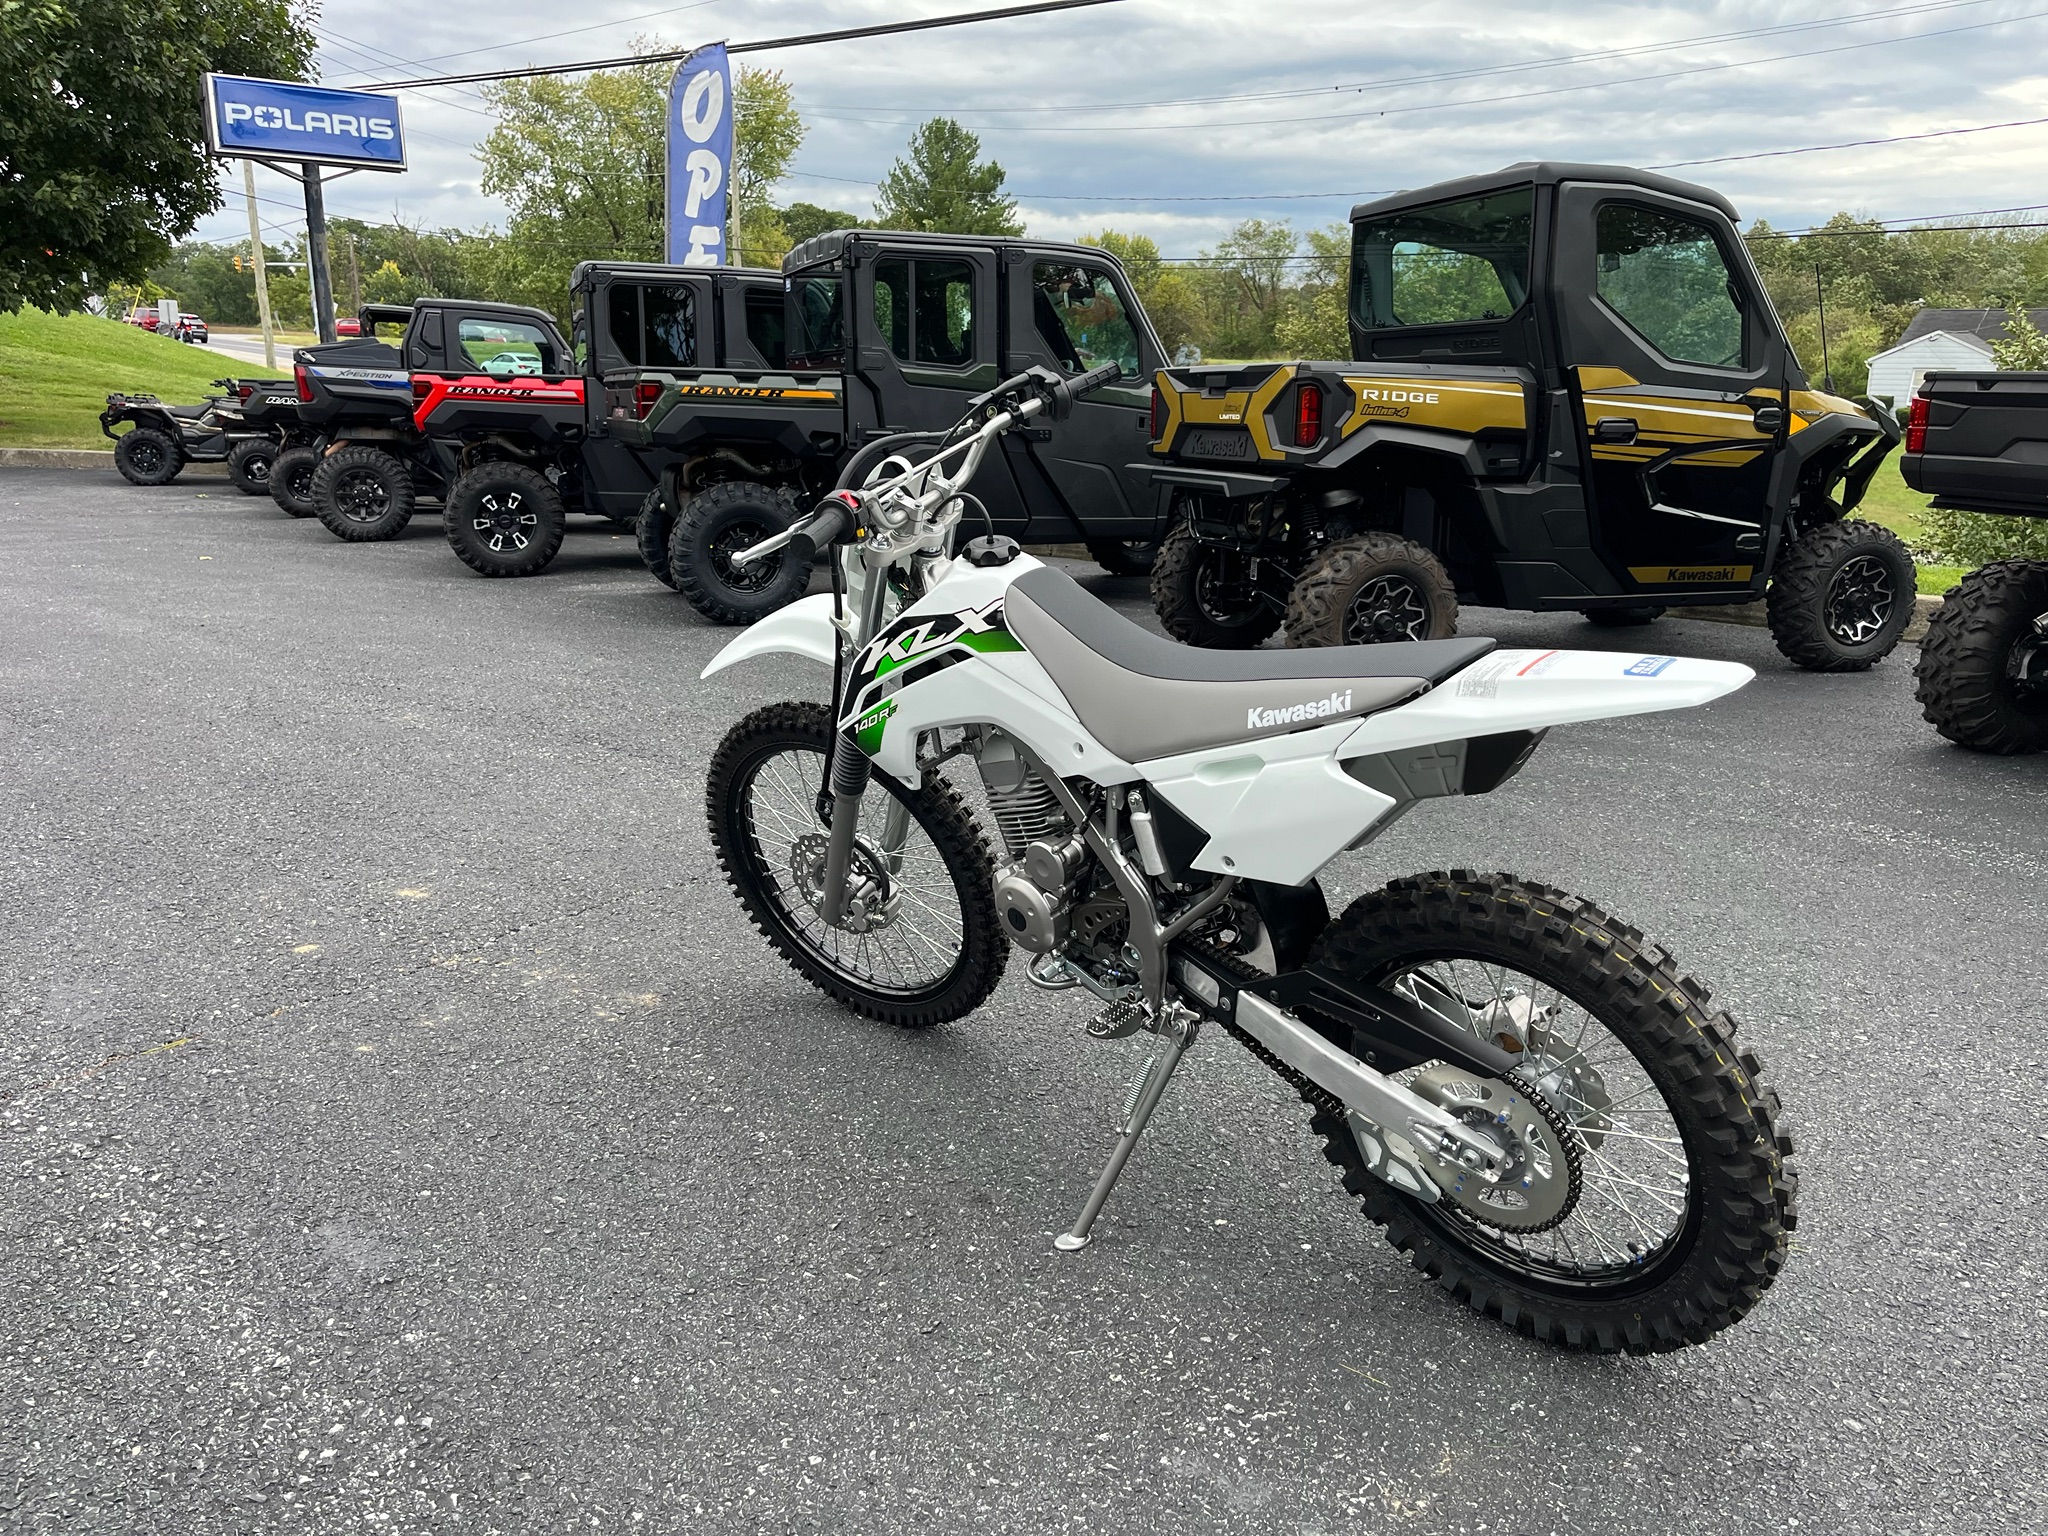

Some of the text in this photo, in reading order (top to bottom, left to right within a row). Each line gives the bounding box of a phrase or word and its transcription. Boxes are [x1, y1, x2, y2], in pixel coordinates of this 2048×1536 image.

[224, 102, 395, 140] POLARIS
[336, 368, 393, 379] XPEDITION
[450, 386, 535, 397] RANGER
[685, 386, 786, 398] RANGER
[1362, 389, 1440, 404] RIDGE
[1360, 403, 1411, 419] Inline-4
[1191, 433, 1249, 458] Kawasaki
[1666, 567, 1736, 582] Kawasaki
[860, 597, 1004, 676] KLX
[1247, 688, 1353, 729] Kawasaki
